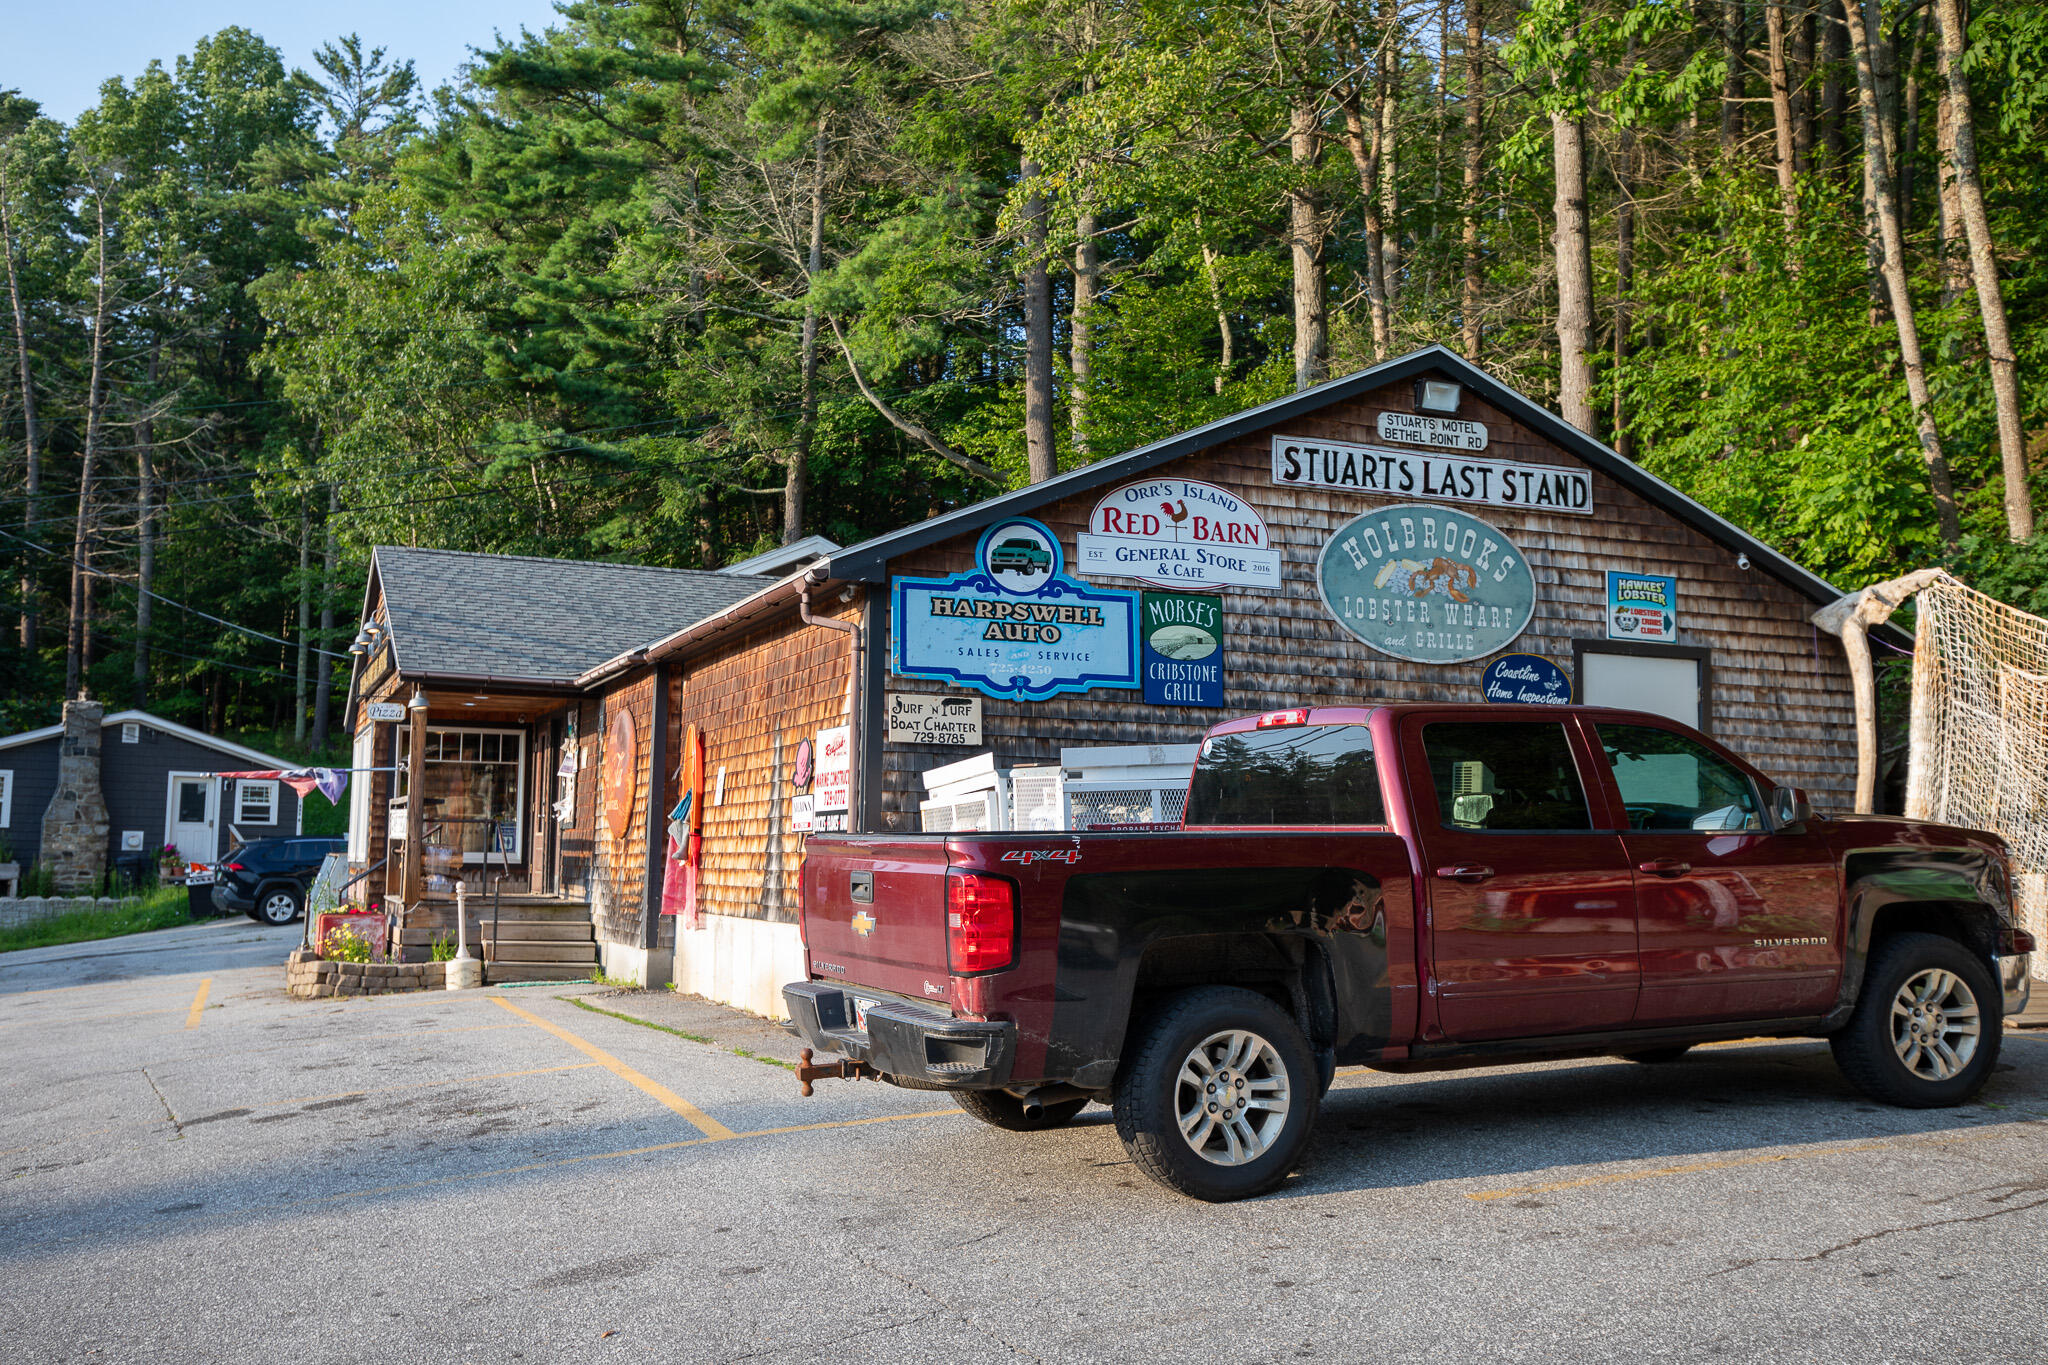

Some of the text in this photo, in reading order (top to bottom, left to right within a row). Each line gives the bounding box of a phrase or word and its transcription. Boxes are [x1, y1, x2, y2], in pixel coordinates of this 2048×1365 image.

[1386, 414, 1478, 434] STUARTS MOTEL
[1384, 428, 1483, 449] BETHEL POINT RD
[1283, 446, 1588, 508] STUARTS LAST STAND
[1124, 483, 1239, 513] ORR'S ISLAND
[1102, 507, 1260, 545] RED BARN
[1088, 550, 1104, 558] EST
[1116, 546, 1247, 572] GENERAL STORE
[1341, 517, 1517, 582] HOLBROOKS
[1157, 562, 1205, 579] & CAFE
[1252, 564, 1271, 573] 2016
[1618, 579, 1666, 593] HAWKES'
[1618, 590, 1667, 607] LOBSTER
[931, 597, 1104, 626] HARPSWELL
[1149, 599, 1218, 627] MORSE'S
[1344, 596, 1513, 629] LOBSTER WHARF
[1630, 607, 1662, 617] LOBSTERS
[983, 622, 1062, 644] AUTO
[1384, 632, 1474, 650] and GRILLE
[958, 647, 1000, 658] SALES
[1038, 651, 1091, 662] SERVICE
[1150, 662, 1217, 682] CRIBSTONE
[1495, 661, 1540, 682] Coastline
[1165, 683, 1204, 702] GRILL
[1487, 681, 1514, 699] Home
[370, 705, 403, 718] Pizza
[892, 695, 924, 714] SURF
[941, 698, 973, 716] TURF
[891, 715, 977, 733] BOAT CHARTER
[1754, 936, 1828, 947] SILVERADO
[813, 960, 846, 975] SILVERADO
